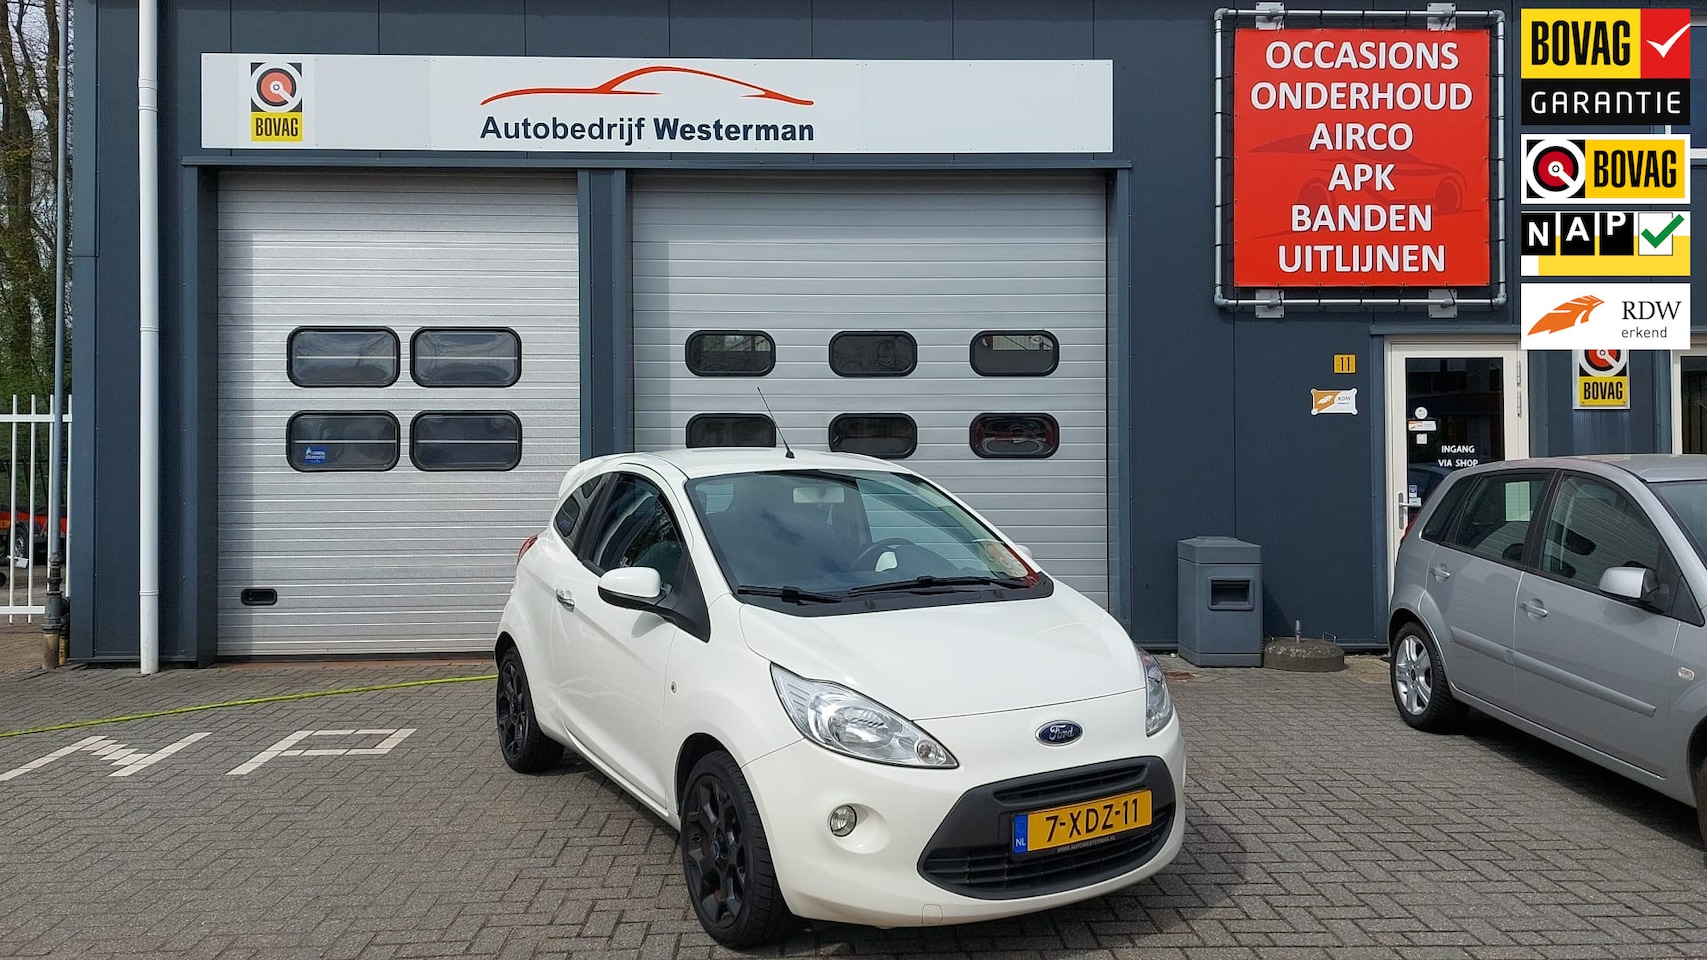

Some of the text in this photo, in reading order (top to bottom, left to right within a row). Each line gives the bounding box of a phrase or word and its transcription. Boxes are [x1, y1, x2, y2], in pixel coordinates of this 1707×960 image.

[1265, 41, 1460, 71] OCCASIONS
[1250, 81, 1473, 111] ONDERHOUD
[255, 117, 299, 138] BOVAG
[480, 115, 814, 147] Autobedrijf Westerman
[1309, 121, 1414, 151] AIRCO
[1328, 163, 1396, 192] APK
[1291, 204, 1432, 233] BANDEN
[1278, 244, 1446, 273] UITLIJNEN
[1340, 356, 1350, 372] 11
[1583, 381, 1624, 401] BOVAG
[1438, 459, 1479, 467] VIA SHOP
[1441, 445, 1475, 453] INGANG
[1049, 724, 1074, 740] Ford
[1045, 797, 1139, 843] 7-XDZ-11
[1015, 837, 1027, 848] NL
